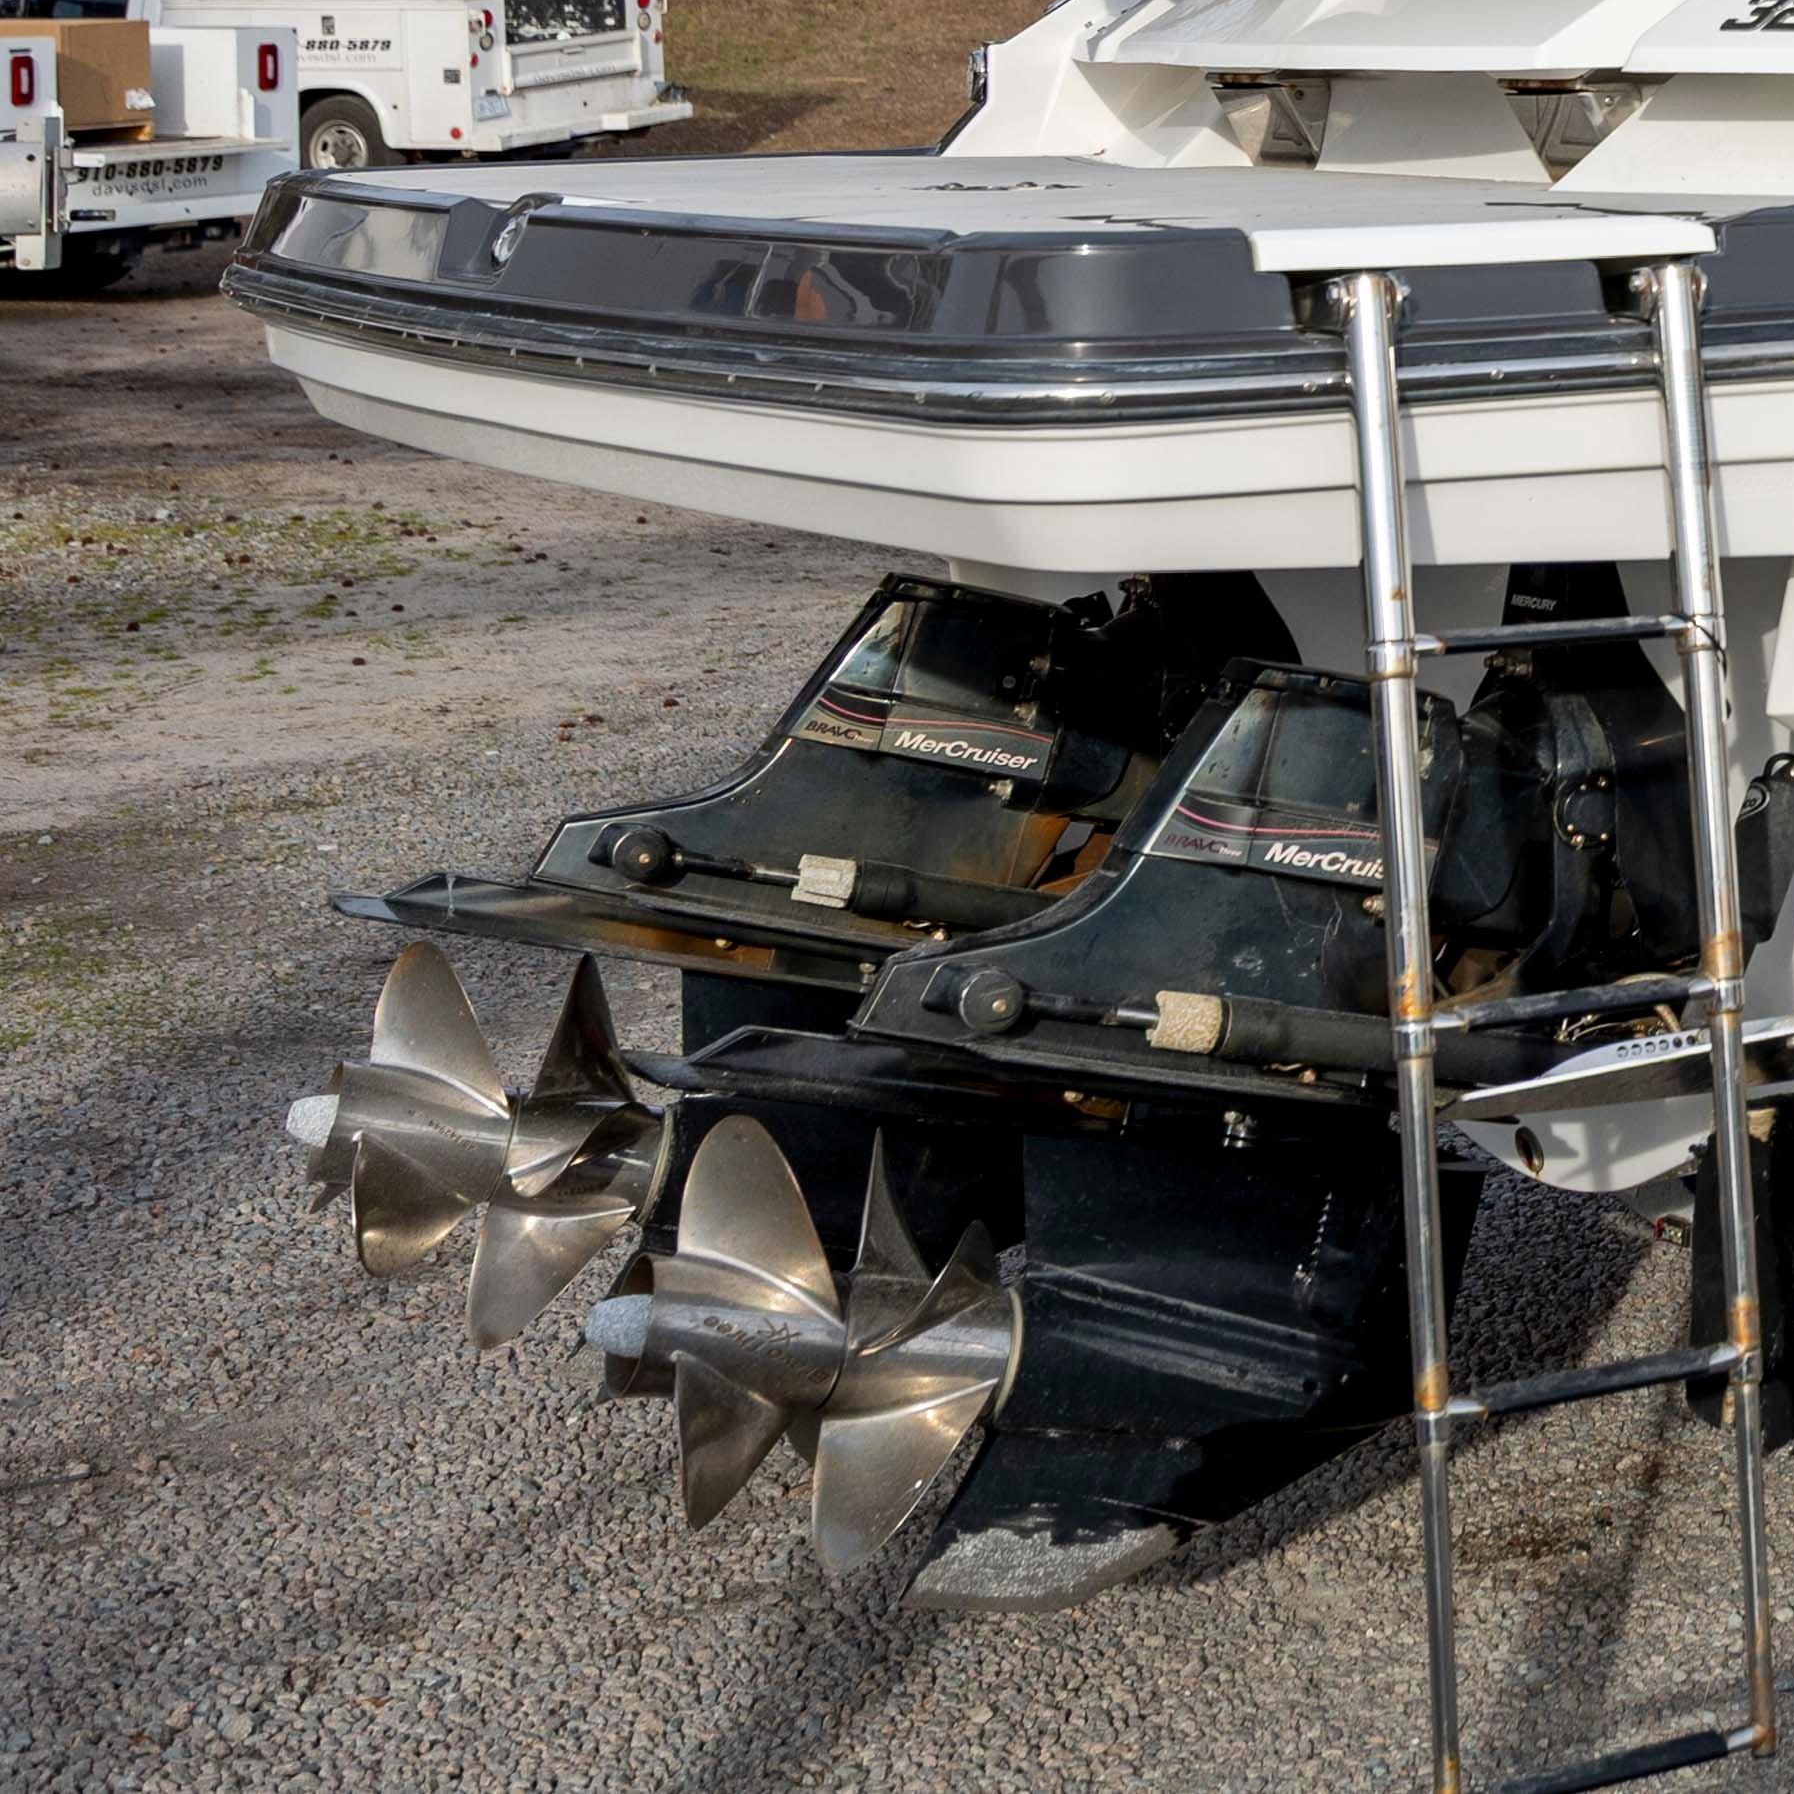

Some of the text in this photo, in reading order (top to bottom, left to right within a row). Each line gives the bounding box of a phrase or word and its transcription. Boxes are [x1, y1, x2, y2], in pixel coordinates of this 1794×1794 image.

[804, 719, 863, 742] BRAVO
[894, 729, 1038, 772] MerCruiser
[1164, 833, 1229, 855] BRAVO
[1263, 841, 1385, 880] MerCruis
